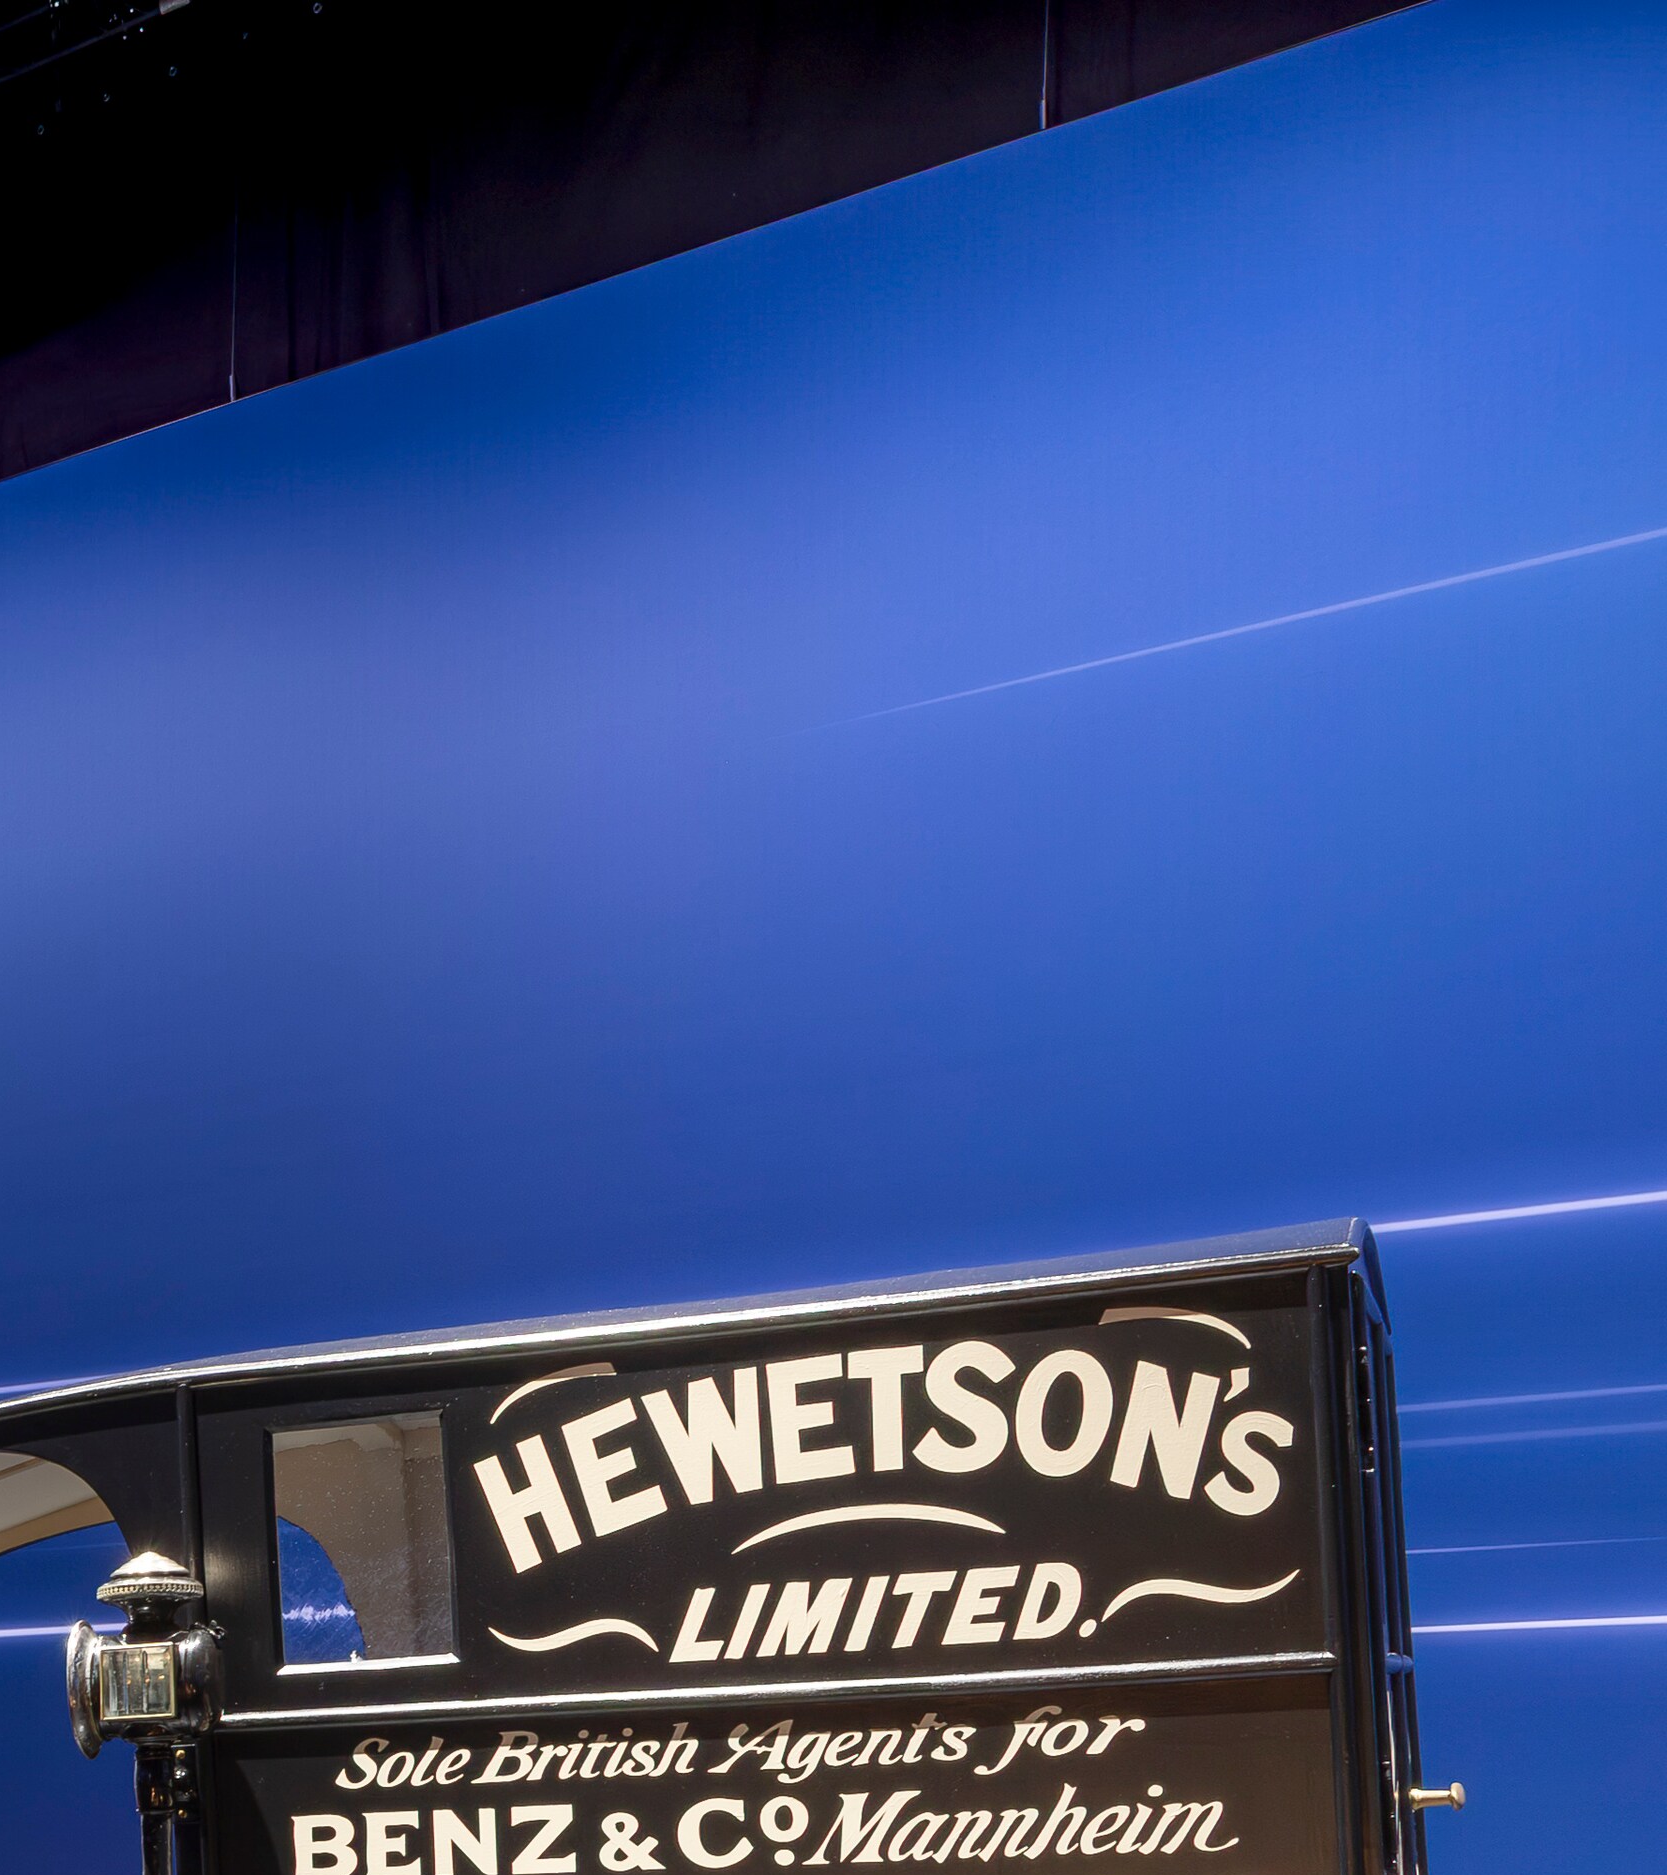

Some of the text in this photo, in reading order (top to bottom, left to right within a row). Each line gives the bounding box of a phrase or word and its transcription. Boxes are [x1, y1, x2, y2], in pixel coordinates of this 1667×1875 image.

[668, 1561, 1098, 1664] LIMITED.
[335, 1705, 1147, 1790] Sole British Agents for
[598, 1812, 667, 1872] &
[801, 1783, 1241, 1866] Mannheim
